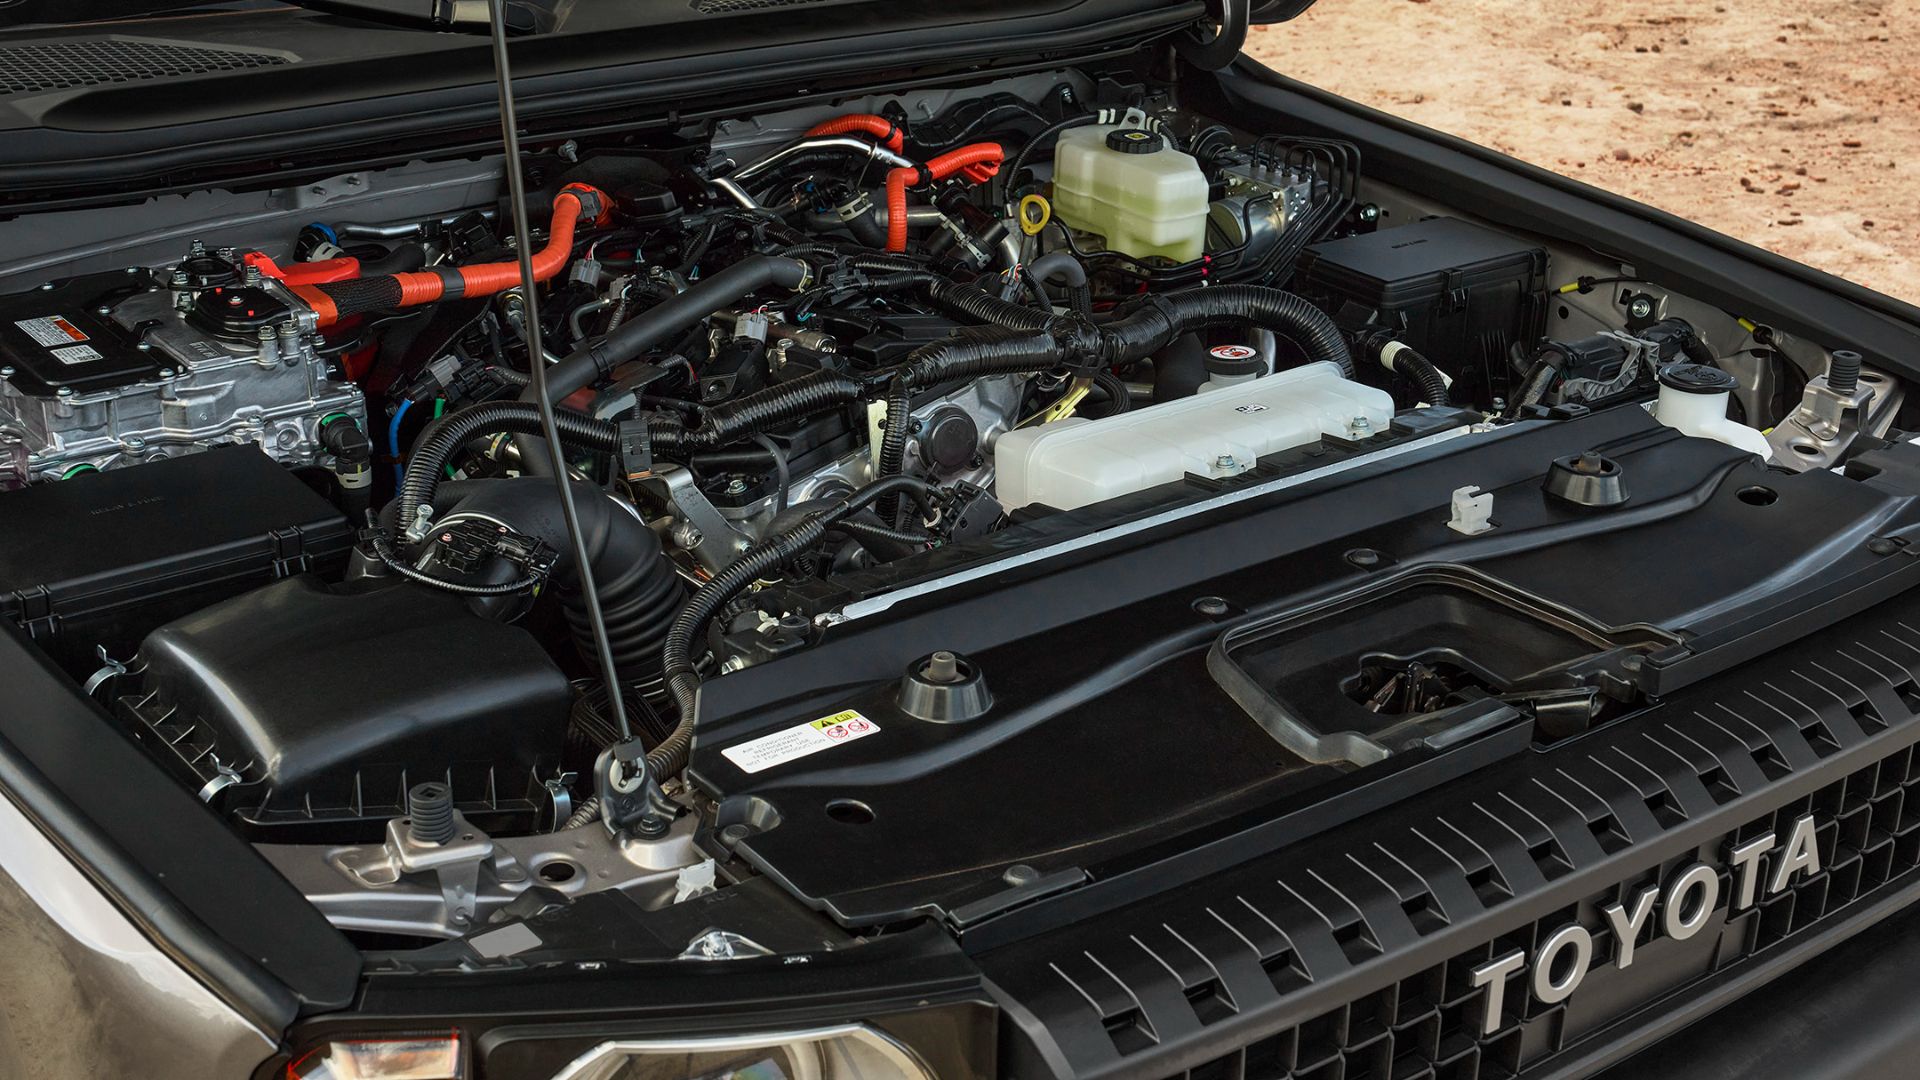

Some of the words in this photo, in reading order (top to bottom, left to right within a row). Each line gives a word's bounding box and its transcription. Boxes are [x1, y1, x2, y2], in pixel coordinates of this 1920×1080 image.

[754, 737, 800, 754] REFRIGERANT
[756, 731, 803, 748] CONDITIONER
[781, 738, 826, 755] PRODUCTION
[753, 744, 793, 759] TEMPORARY
[1470, 813, 1821, 1035] TOYOTA
